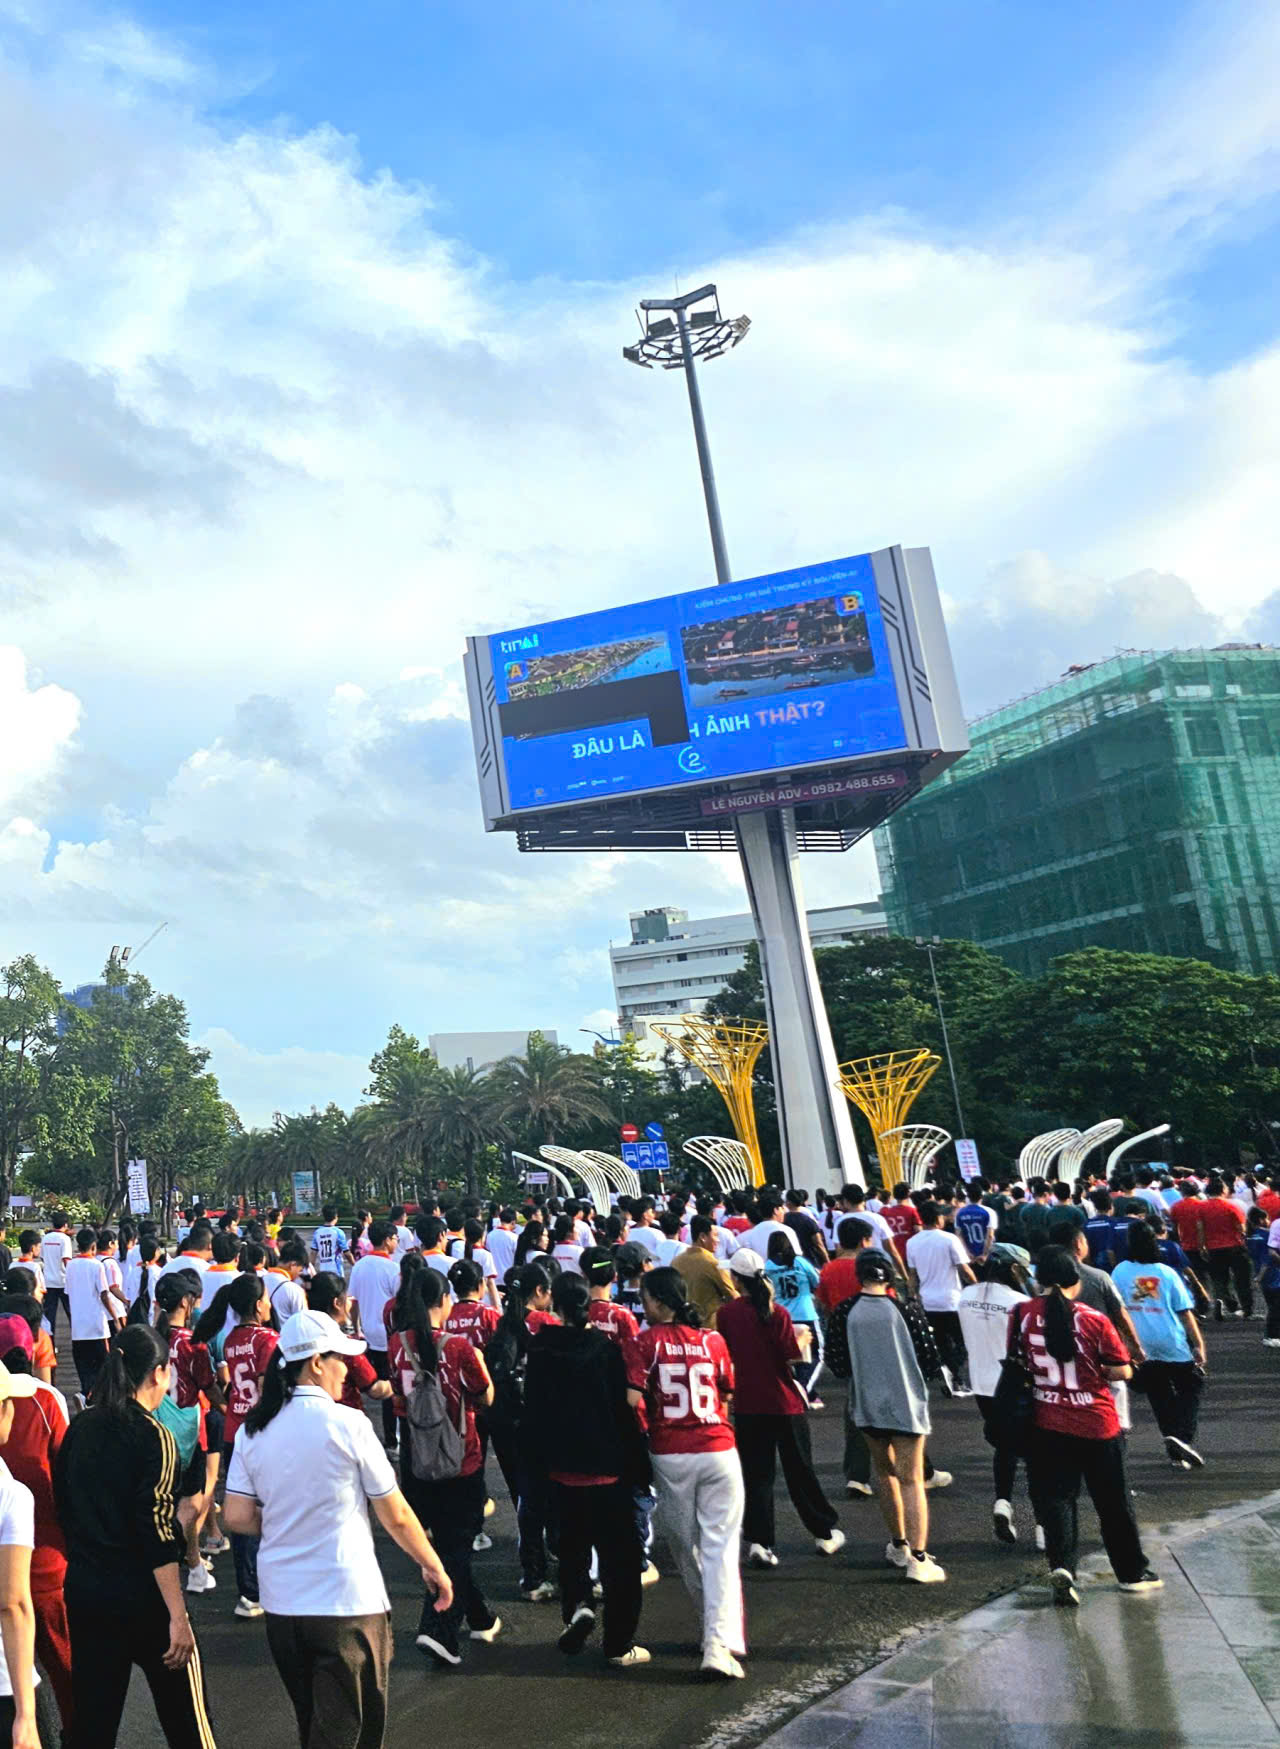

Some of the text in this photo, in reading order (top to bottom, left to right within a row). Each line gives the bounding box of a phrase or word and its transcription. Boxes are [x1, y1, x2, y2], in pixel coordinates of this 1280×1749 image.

[841, 596, 860, 611] B
[511, 664, 523, 679] A
[572, 737, 614, 759] ĐÂU
[620, 729, 646, 751] LÀ
[706, 713, 751, 737] ẢNH
[963, 1222, 985, 1244] 10
[658, 1362, 715, 1419] 56
